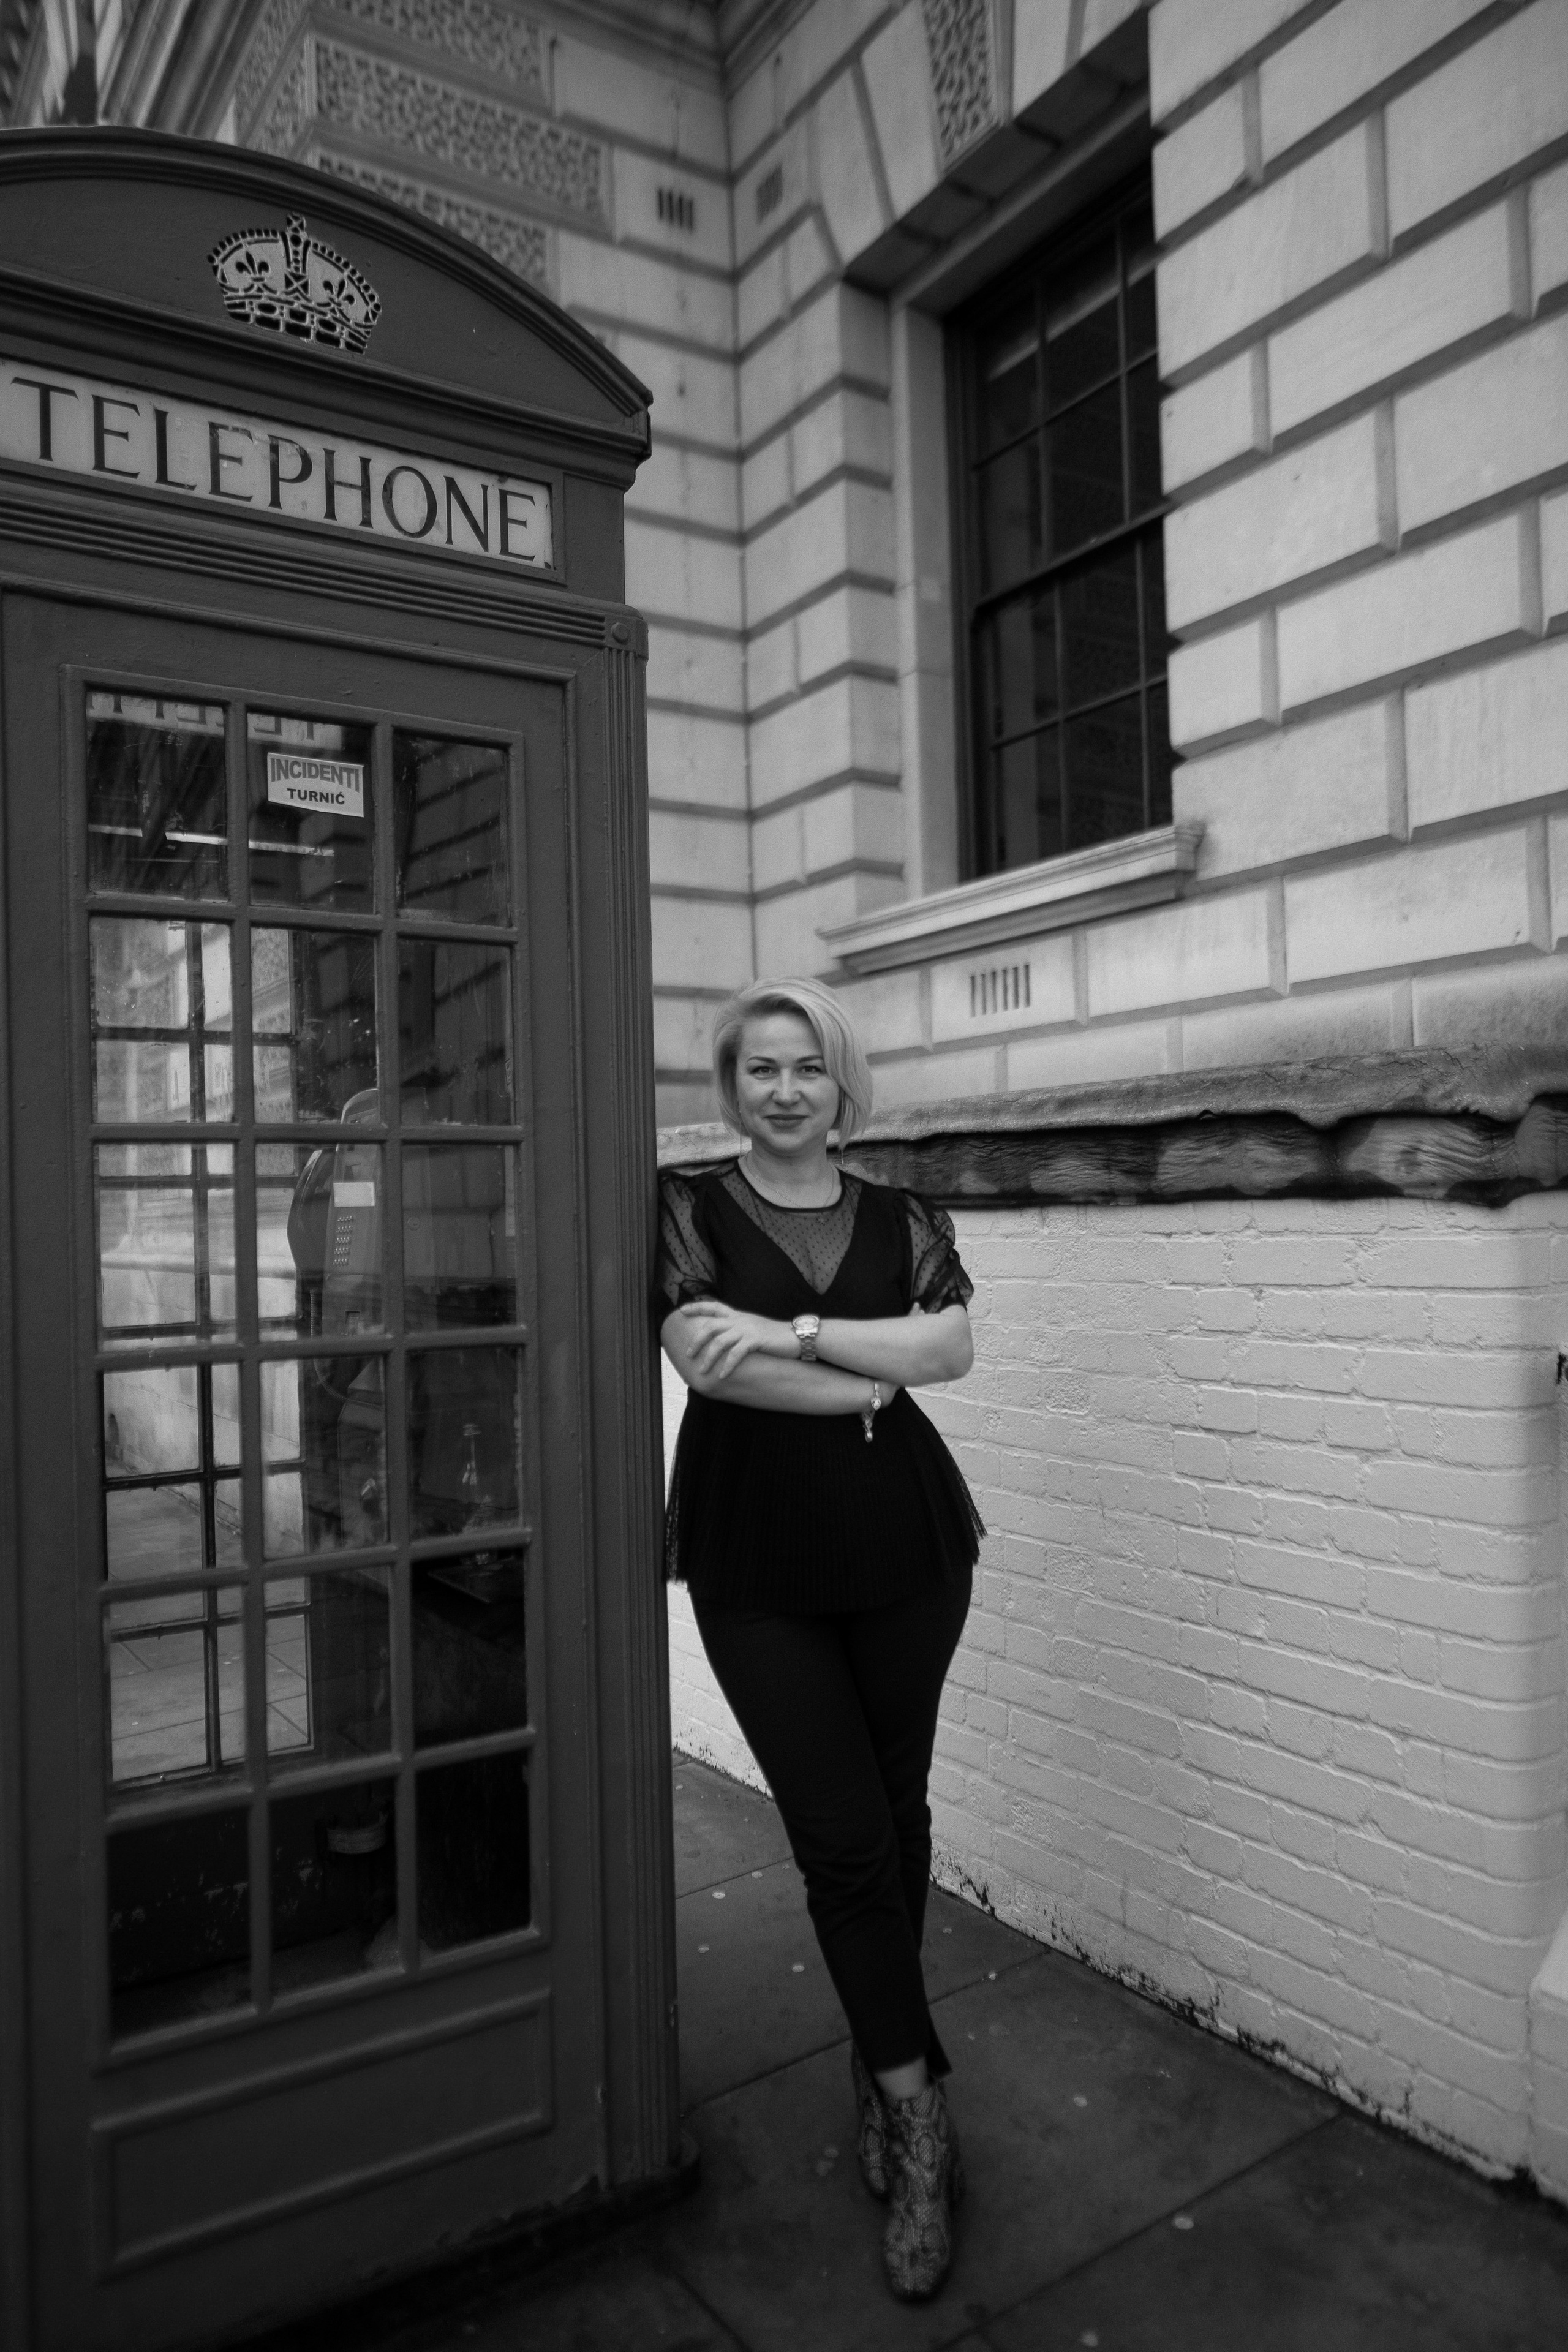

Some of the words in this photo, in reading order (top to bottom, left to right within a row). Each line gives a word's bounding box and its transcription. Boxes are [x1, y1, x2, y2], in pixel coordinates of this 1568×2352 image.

[10, 377, 535, 562] TELEPHONE
[270, 758, 360, 793] INCIDENTI
[287, 788, 345, 805] TURNIĆ
